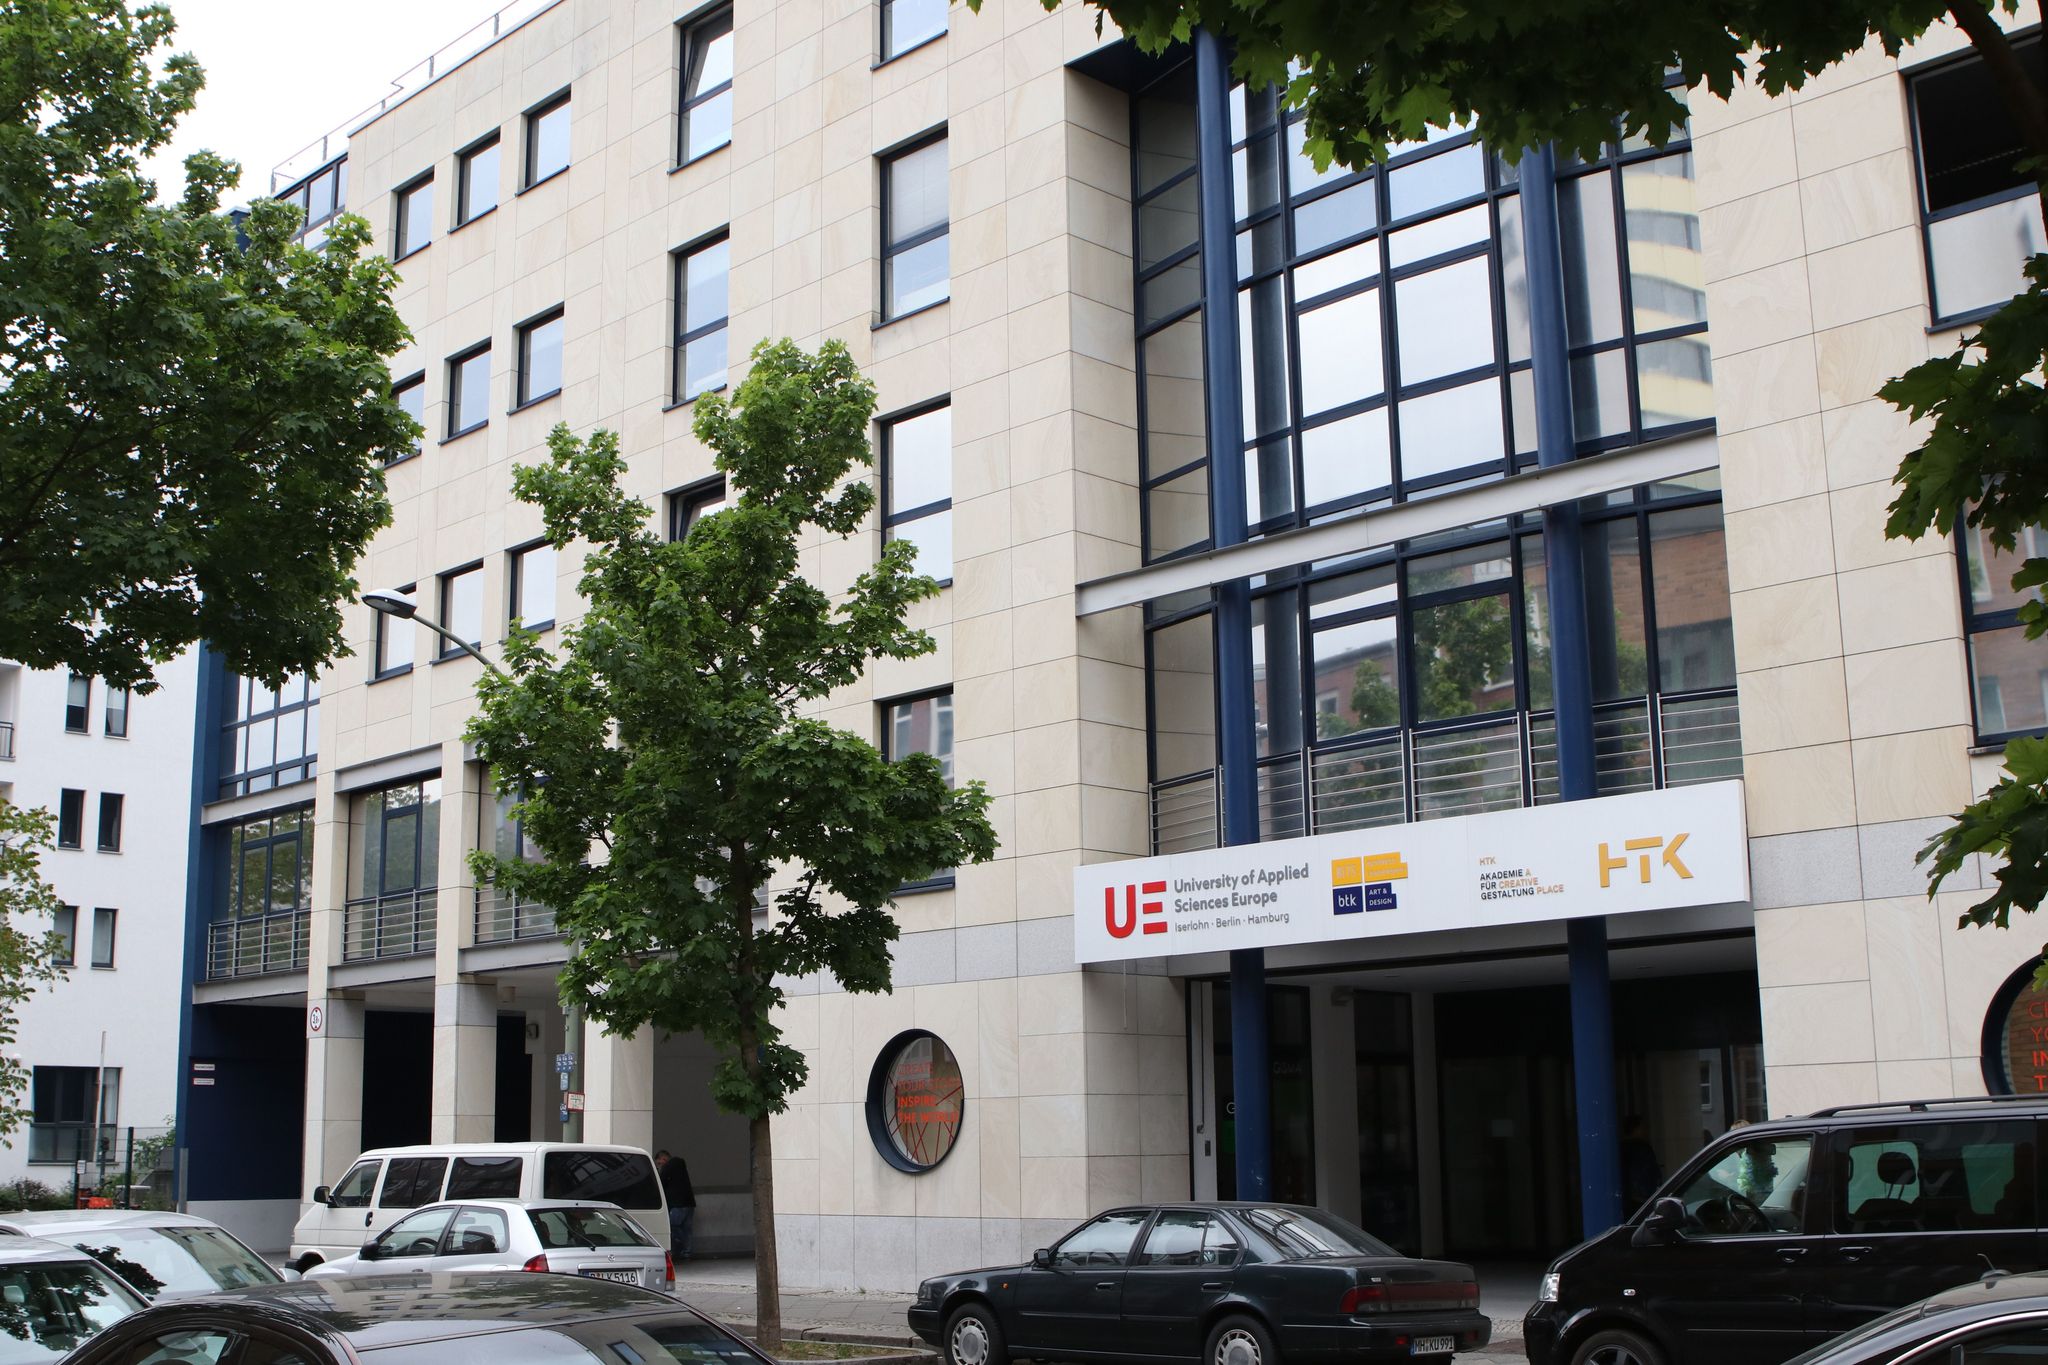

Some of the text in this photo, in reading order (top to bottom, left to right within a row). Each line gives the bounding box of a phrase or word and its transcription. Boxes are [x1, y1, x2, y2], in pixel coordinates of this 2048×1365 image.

[1479, 856, 1497, 866] HTK
[1598, 832, 1694, 888] HTK
[1174, 863, 1309, 894] University of Applied
[1480, 868, 1523, 881] AKADEMIE
[1480, 876, 1539, 891] FÜR CREATIVE
[1369, 888, 1382, 896] ART
[1480, 884, 1565, 900] GESTALTUNG PLACE
[1174, 892, 1278, 913] Sciences Europe
[1338, 894, 1357, 908] btk
[1369, 898, 1392, 906] DESIGN
[1105, 880, 1168, 938] UE
[1175, 912, 1290, 932] Iserlohn Berlin Hamburg
[897, 1095, 936, 1108] INSPIRE
[898, 1111, 917, 1123] THE
[1441, 1338, 1453, 1349] 991
